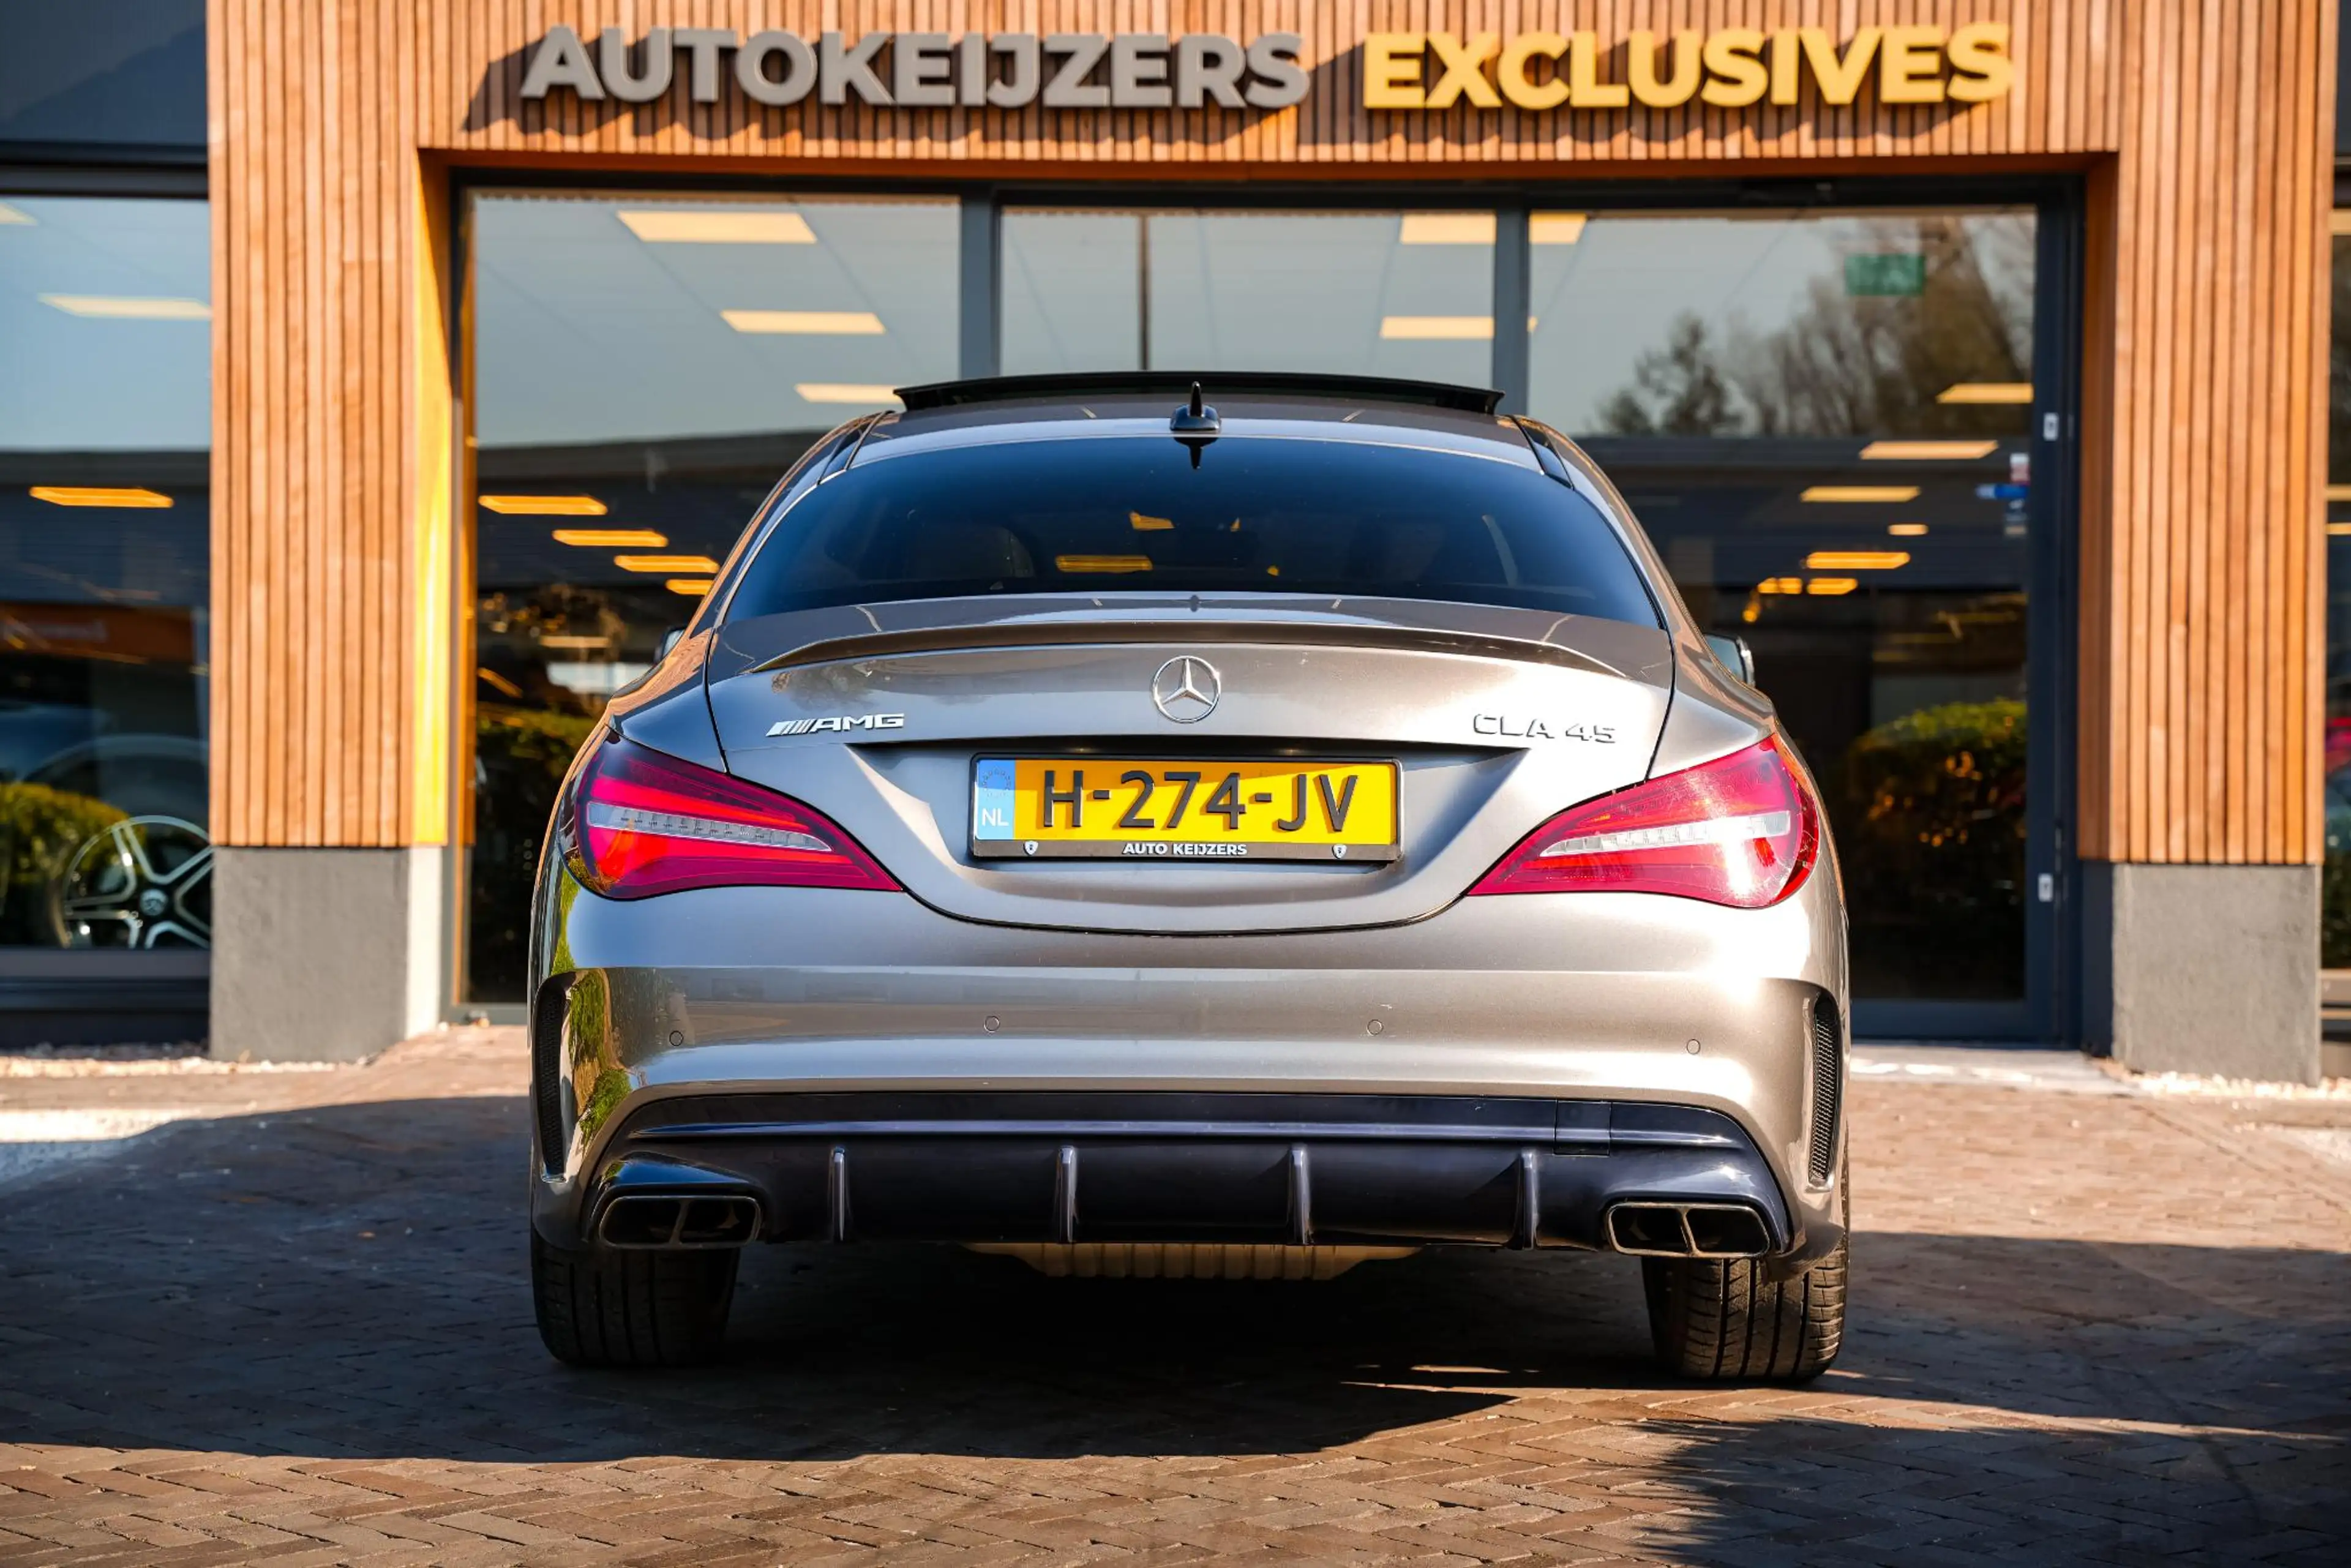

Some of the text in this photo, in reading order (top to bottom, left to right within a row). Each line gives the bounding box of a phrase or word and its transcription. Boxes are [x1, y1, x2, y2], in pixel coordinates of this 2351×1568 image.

[519, 23, 2012, 109] AUTOKEIJZERS EXCLUSIVES
[808, 713, 904, 733] AMG
[1473, 714, 1616, 743] CLA 45
[1043, 770, 1359, 832] H-274-JV
[981, 808, 1009, 827] NL
[1123, 842, 1248, 856] AUTO KEIJZERS
